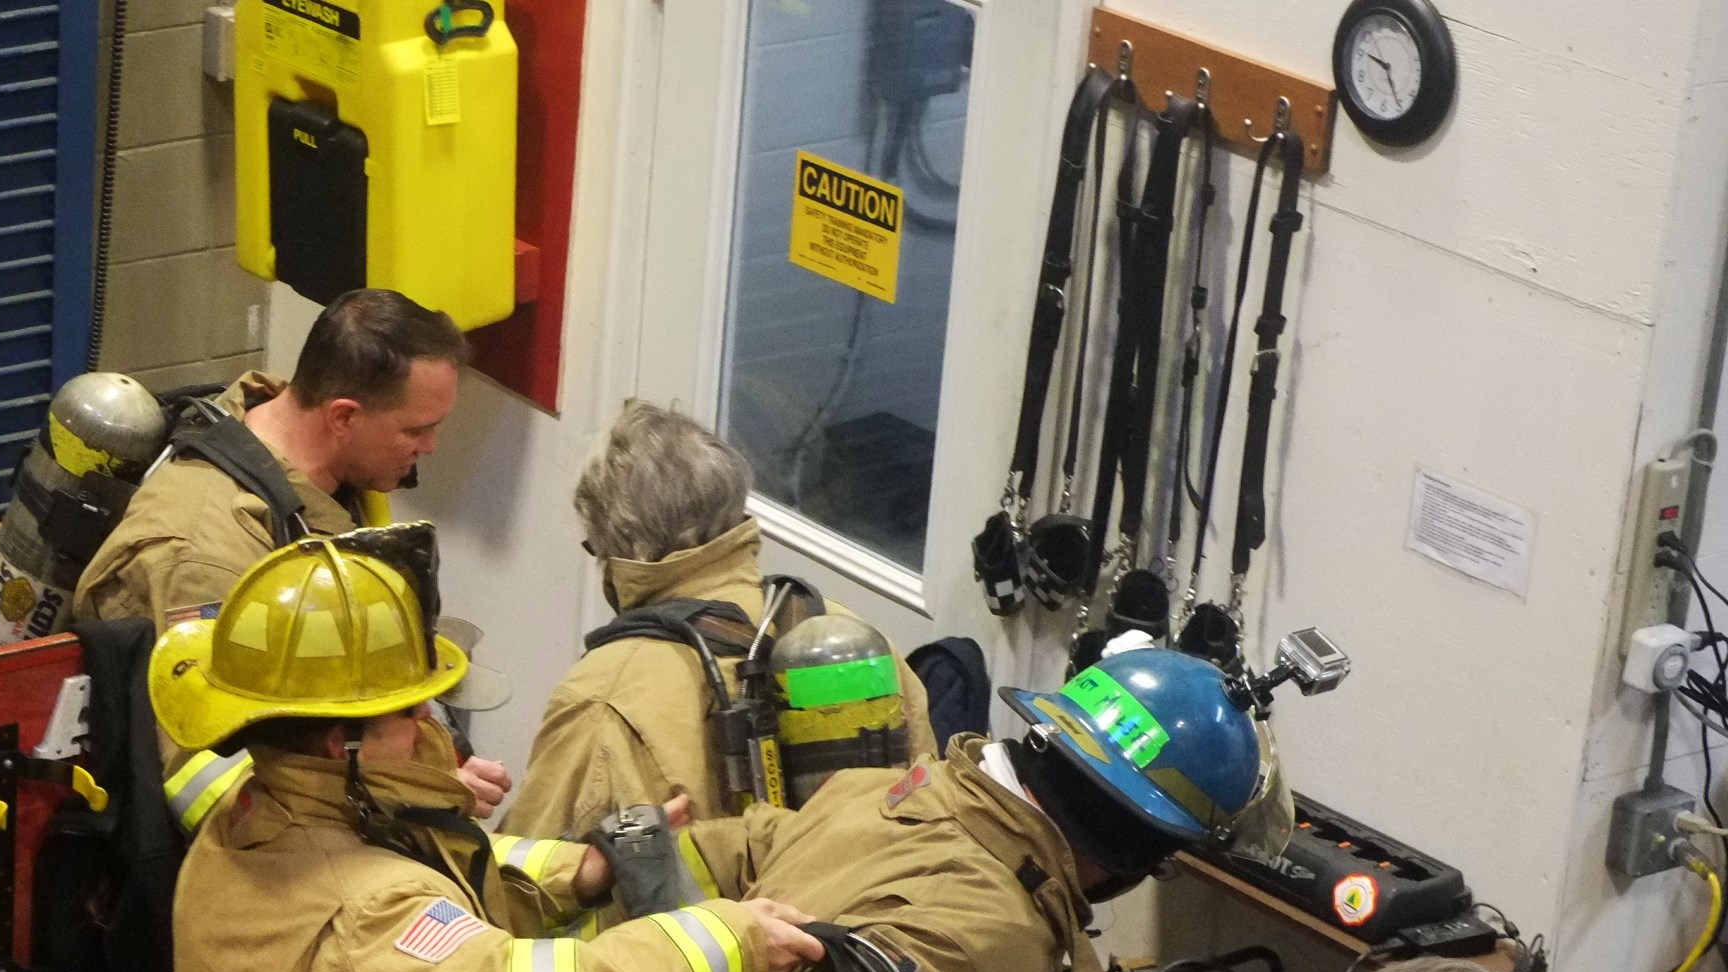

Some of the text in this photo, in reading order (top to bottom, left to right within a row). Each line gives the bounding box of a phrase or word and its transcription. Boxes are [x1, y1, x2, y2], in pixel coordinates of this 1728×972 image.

[293, 128, 318, 149] PULL
[802, 166, 897, 226] CAUTION
[23, 588, 64, 640] SCOT
